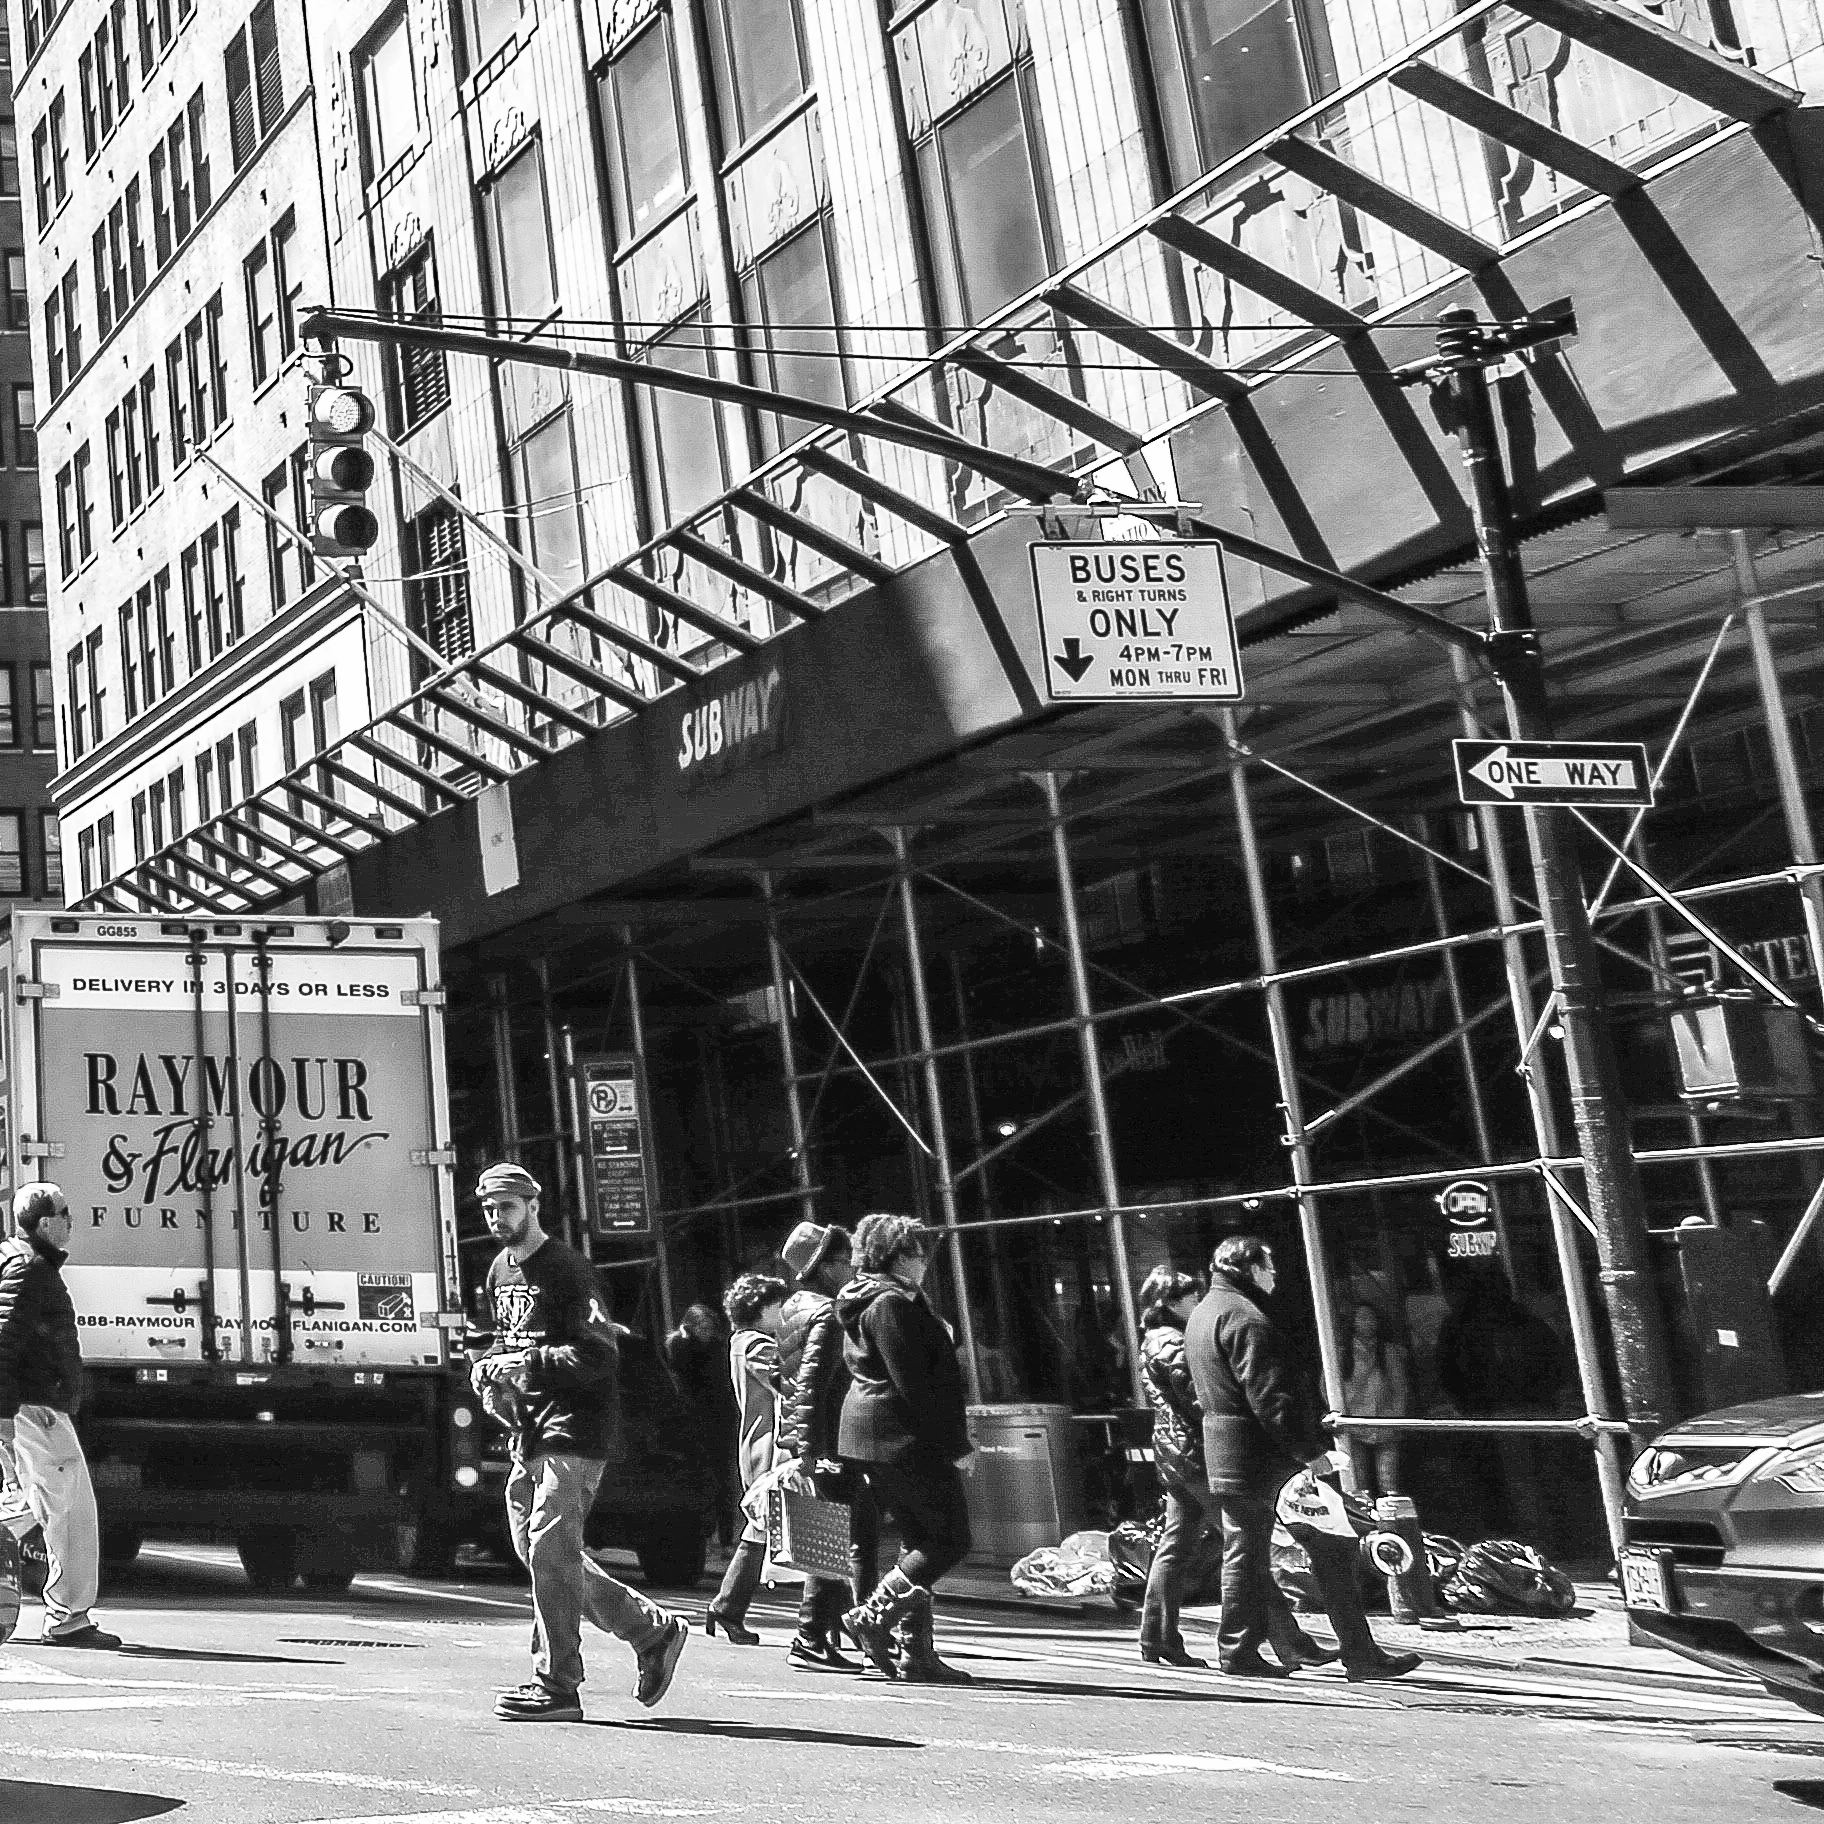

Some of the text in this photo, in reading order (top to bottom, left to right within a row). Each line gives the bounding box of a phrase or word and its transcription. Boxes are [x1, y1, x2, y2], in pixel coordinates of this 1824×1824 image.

[1069, 553, 1187, 585] BUSES
[1076, 589, 1188, 603] & RIGHT TURNS
[1089, 608, 1180, 638] ONLY
[1118, 644, 1213, 663] 4PM-7PM
[1109, 667, 1229, 688] MON THRU FRI
[677, 666, 782, 770] SUBWAY
[1487, 760, 1624, 788] ONE WAY
[72, 977, 390, 999] DELIVERY IN 3 DAYS OR LESS
[83, 1052, 374, 1122] RAYMOUR
[101, 1133, 143, 1194] &
